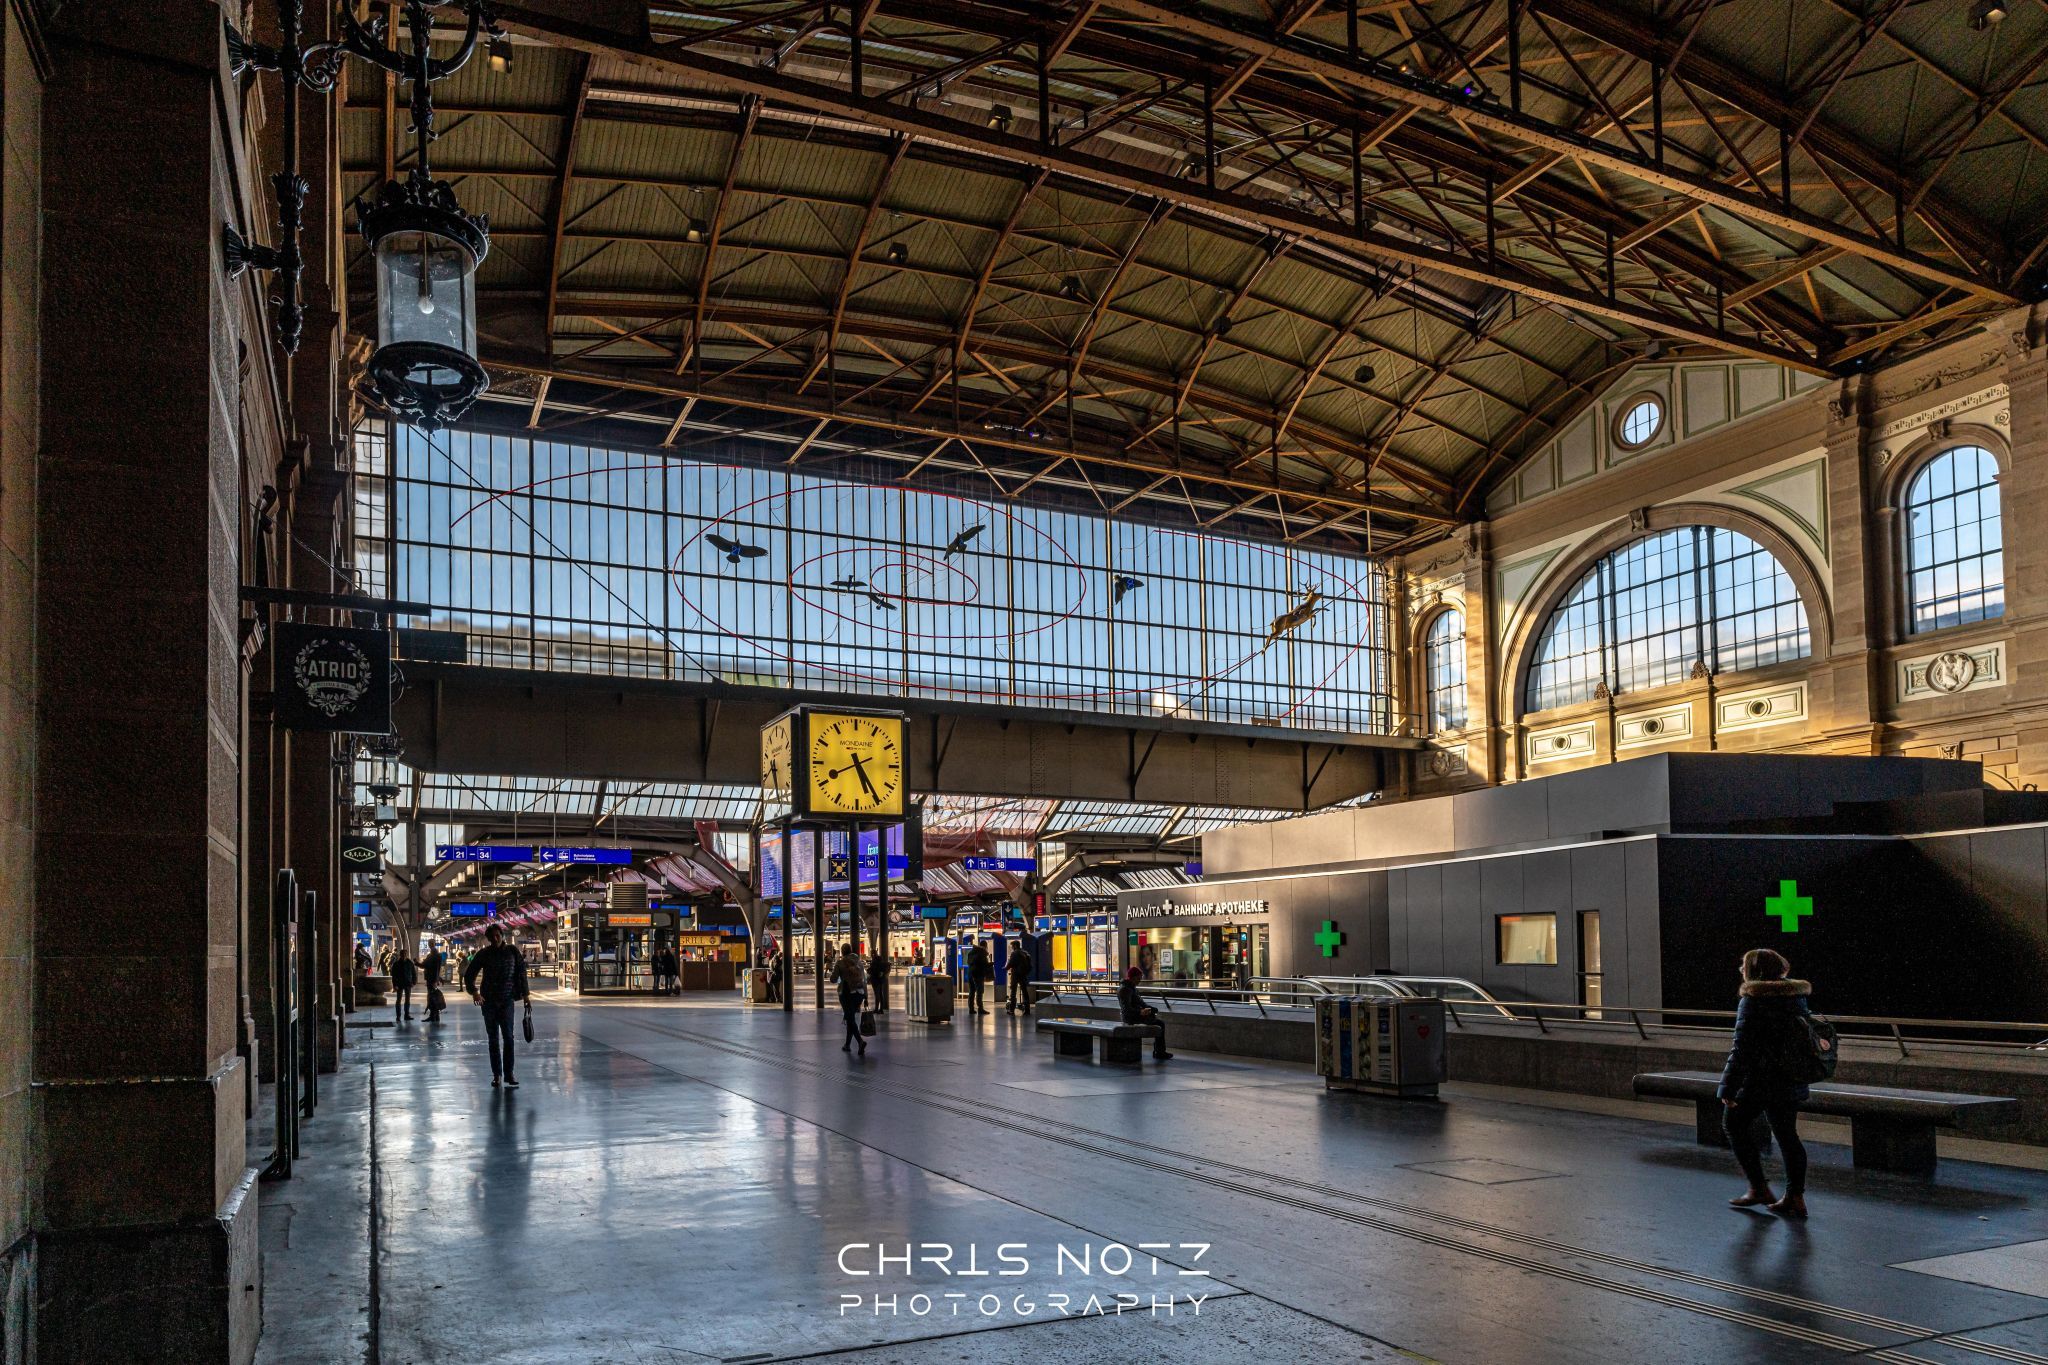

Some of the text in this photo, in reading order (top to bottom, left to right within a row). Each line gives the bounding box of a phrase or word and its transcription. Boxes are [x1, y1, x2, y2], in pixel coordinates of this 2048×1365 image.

[308, 660, 357, 679] ATRIO
[839, 740, 873, 748] MONDAINE
[455, 851, 465, 859] 21
[479, 851, 490, 859] 34
[866, 859, 875, 867] 10
[996, 861, 1005, 869] 18
[1174, 903, 1214, 916] BAHNHOF
[1215, 899, 1265, 915] APOTHEKE
